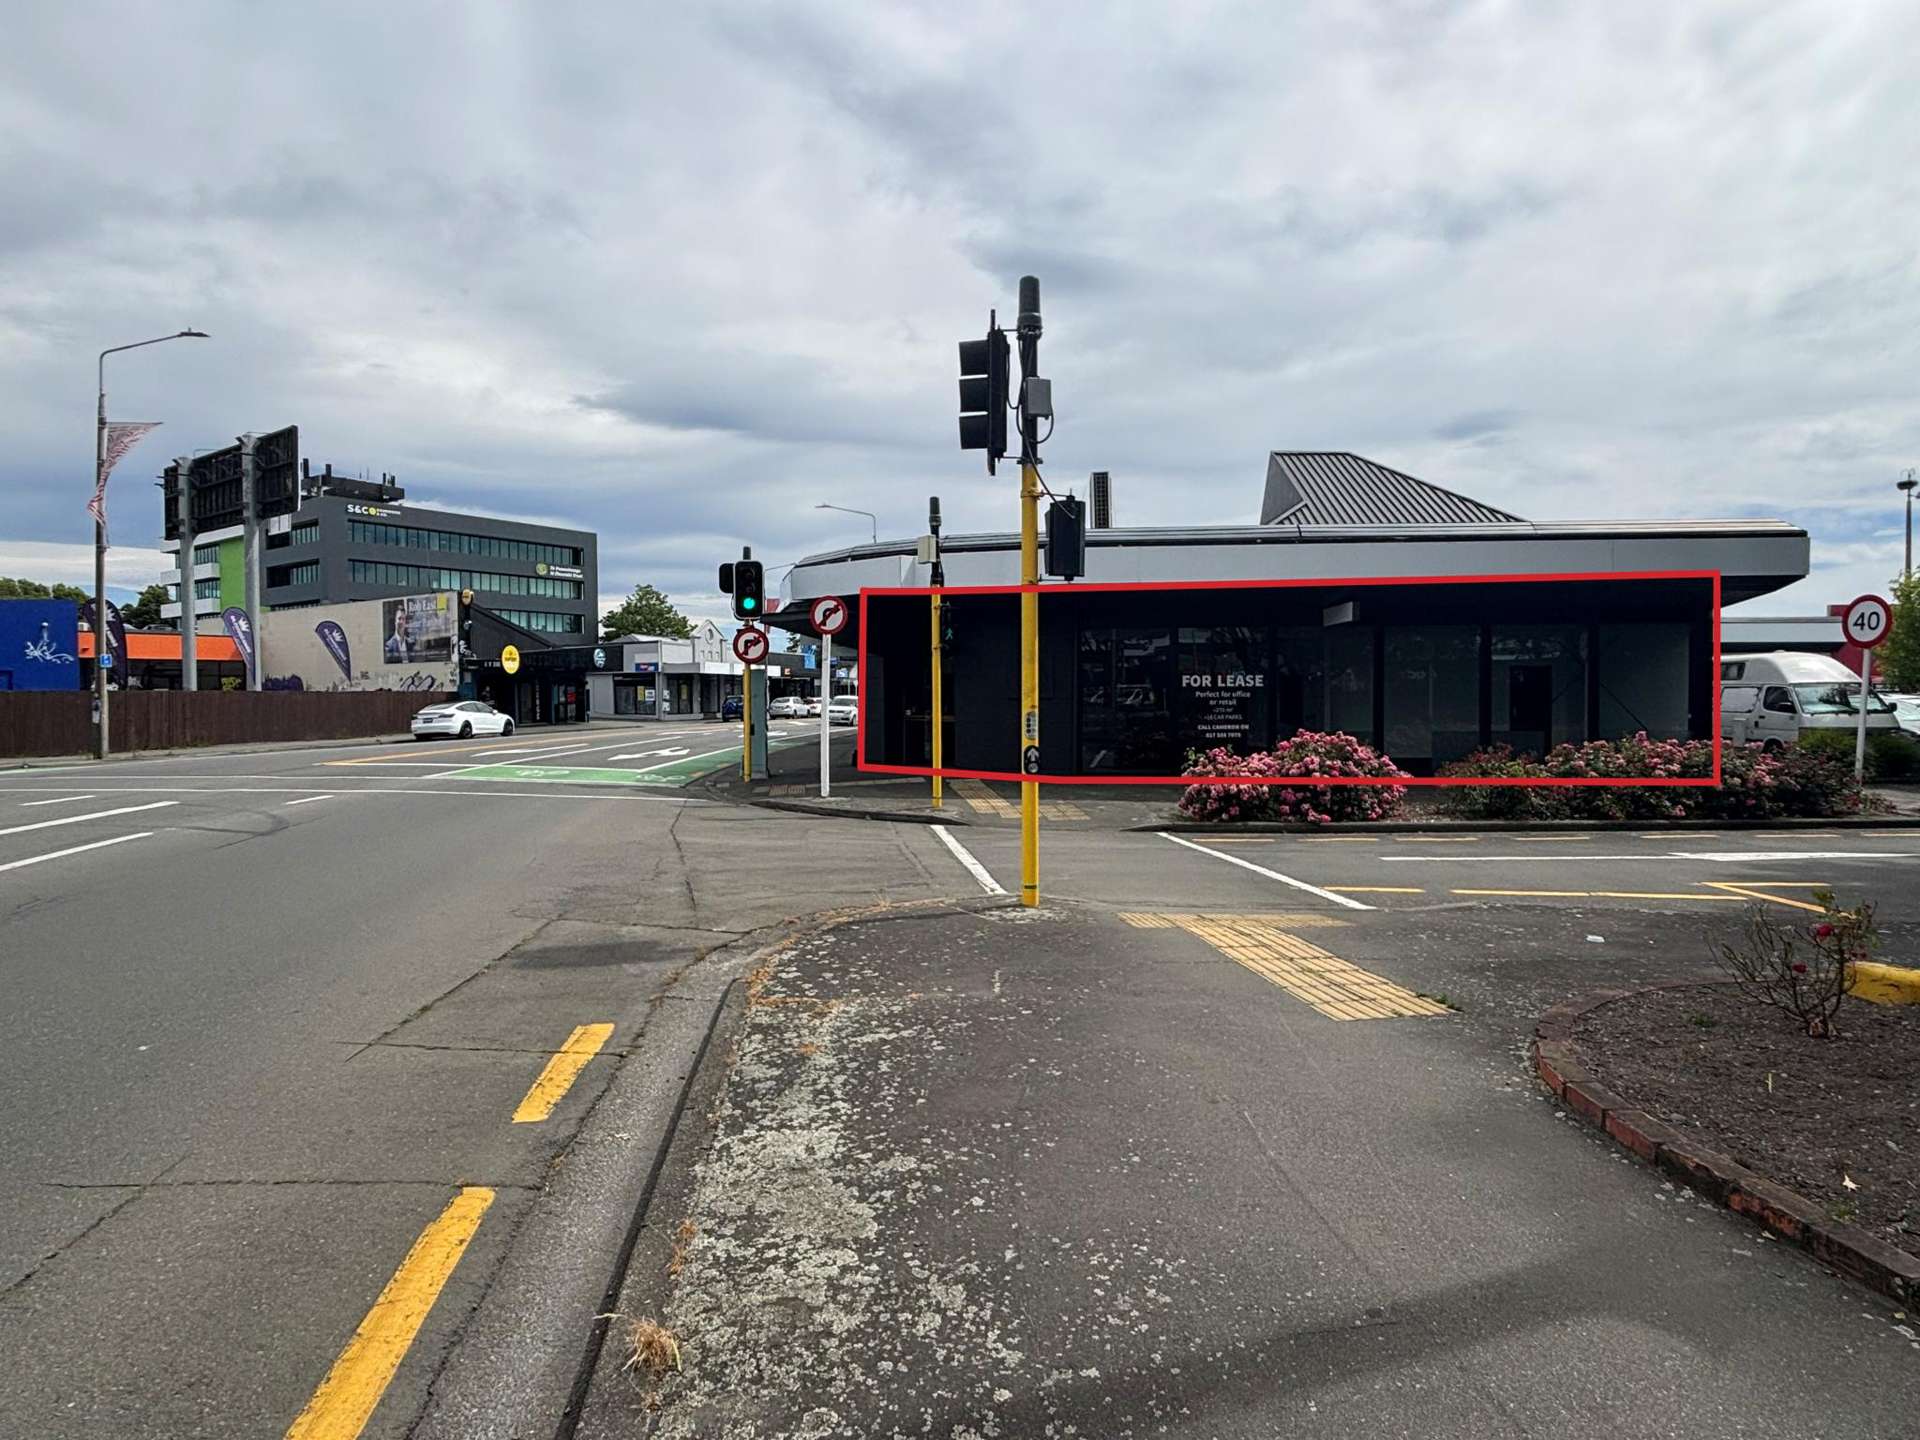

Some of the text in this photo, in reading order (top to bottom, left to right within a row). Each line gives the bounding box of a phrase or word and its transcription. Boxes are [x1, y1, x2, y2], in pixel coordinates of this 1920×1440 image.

[1853, 611, 1880, 631] 40
[1182, 675, 1264, 687] FOR LEASE
[1195, 690, 1251, 698] Perfect for office
